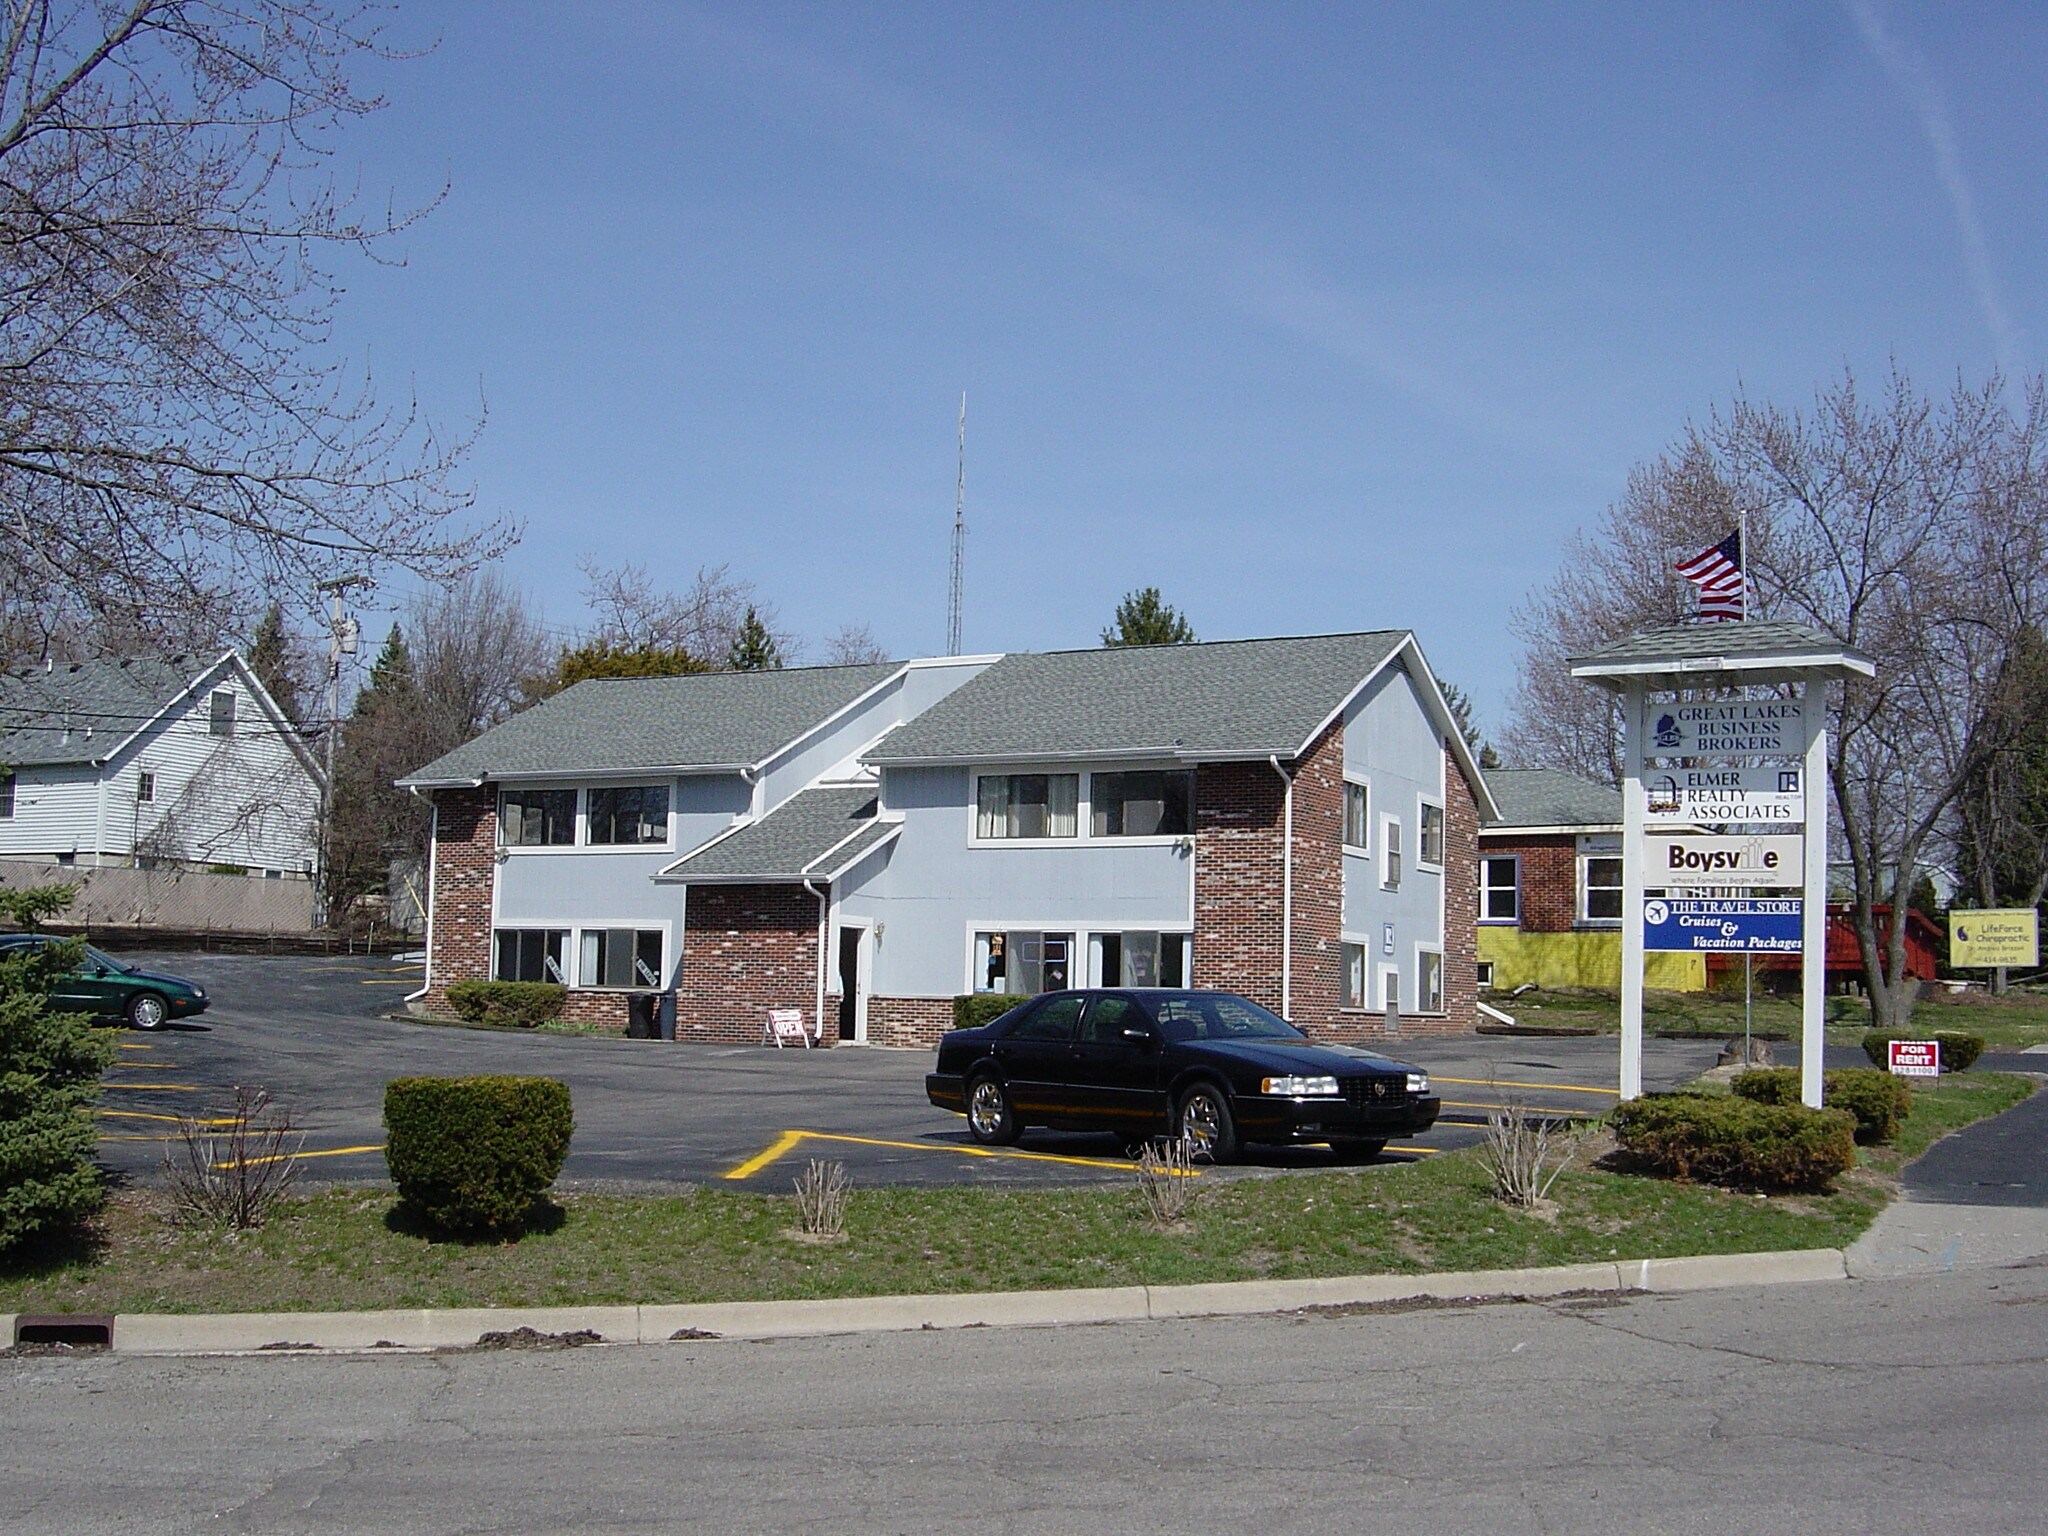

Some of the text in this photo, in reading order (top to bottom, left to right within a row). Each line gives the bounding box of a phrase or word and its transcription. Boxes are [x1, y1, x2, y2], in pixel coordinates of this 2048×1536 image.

[1678, 704, 1801, 721] GREAT LAKES
[1698, 721, 1781, 736] BUSINESS
[1698, 736, 1781, 751] BROKERS
[1688, 772, 1740, 786] ELMER
[1688, 789, 1748, 803] REALTY
[1688, 805, 1791, 819] ASSOCIATES
[1669, 837, 1779, 872] Boysville
[1670, 901, 1801, 913] THE TRAVEL STORE
[1679, 915, 1721, 927] Cruises
[1721, 921, 1739, 936] &
[1981, 924, 2024, 933] LifeForce
[1693, 936, 1802, 950] Vacation Packages
[1976, 934, 2030, 945] Chiropractic
[775, 1021, 804, 1036] OPEN
[1900, 1045, 1926, 1054] FOR
[1895, 1054, 1932, 1065] RENT
